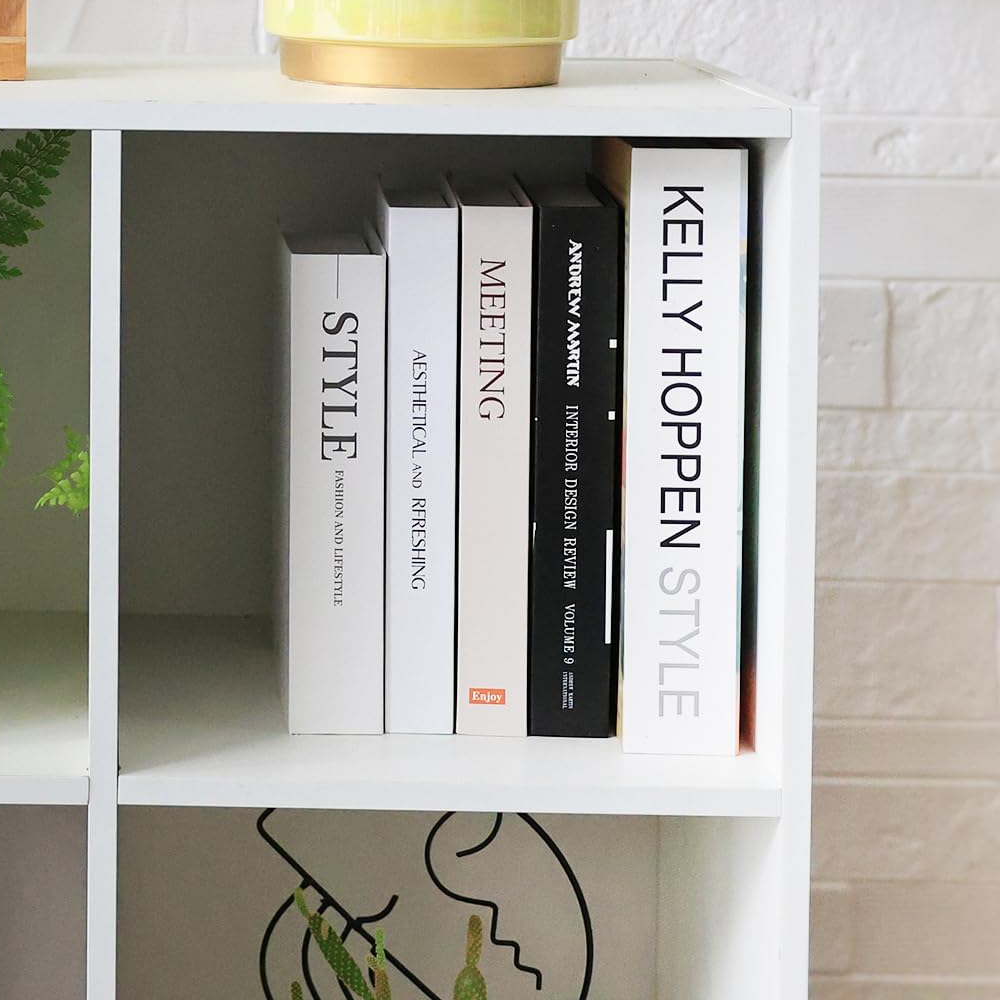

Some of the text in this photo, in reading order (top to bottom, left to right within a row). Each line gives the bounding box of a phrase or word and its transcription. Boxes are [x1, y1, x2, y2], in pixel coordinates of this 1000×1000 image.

[412, 349, 427, 459] AESTHETICAL
[478, 258, 506, 421] MEETING
[321, 311, 359, 607] STYLE FASHION AND LIFESTYLE
[411, 464, 423, 489] AND
[563, 238, 583, 665] ANDREW MARTIN INTERIOR DESIGN REVIEW VOLUME 9
[658, 186, 705, 717] KELLY HOPPEN STYLE
[472, 691, 502, 704] Enjoy
